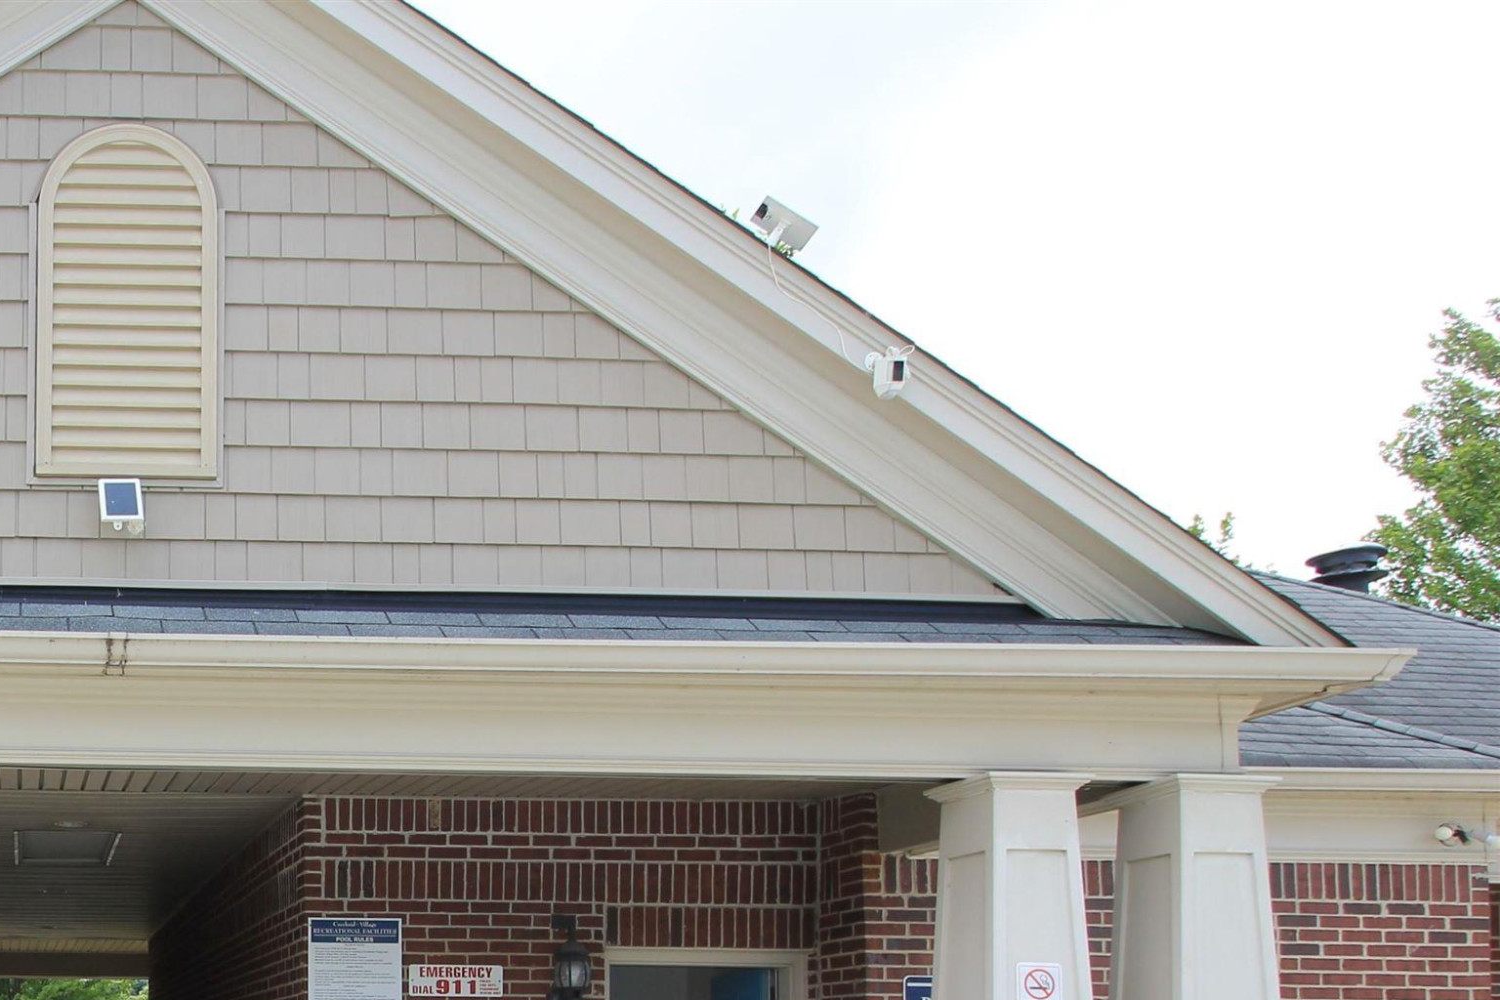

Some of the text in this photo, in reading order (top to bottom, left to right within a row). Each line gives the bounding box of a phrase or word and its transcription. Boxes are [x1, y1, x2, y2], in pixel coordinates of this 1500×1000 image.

[419, 966, 493, 979] EMERGENCY
[412, 979, 477, 995] DIAL 911
